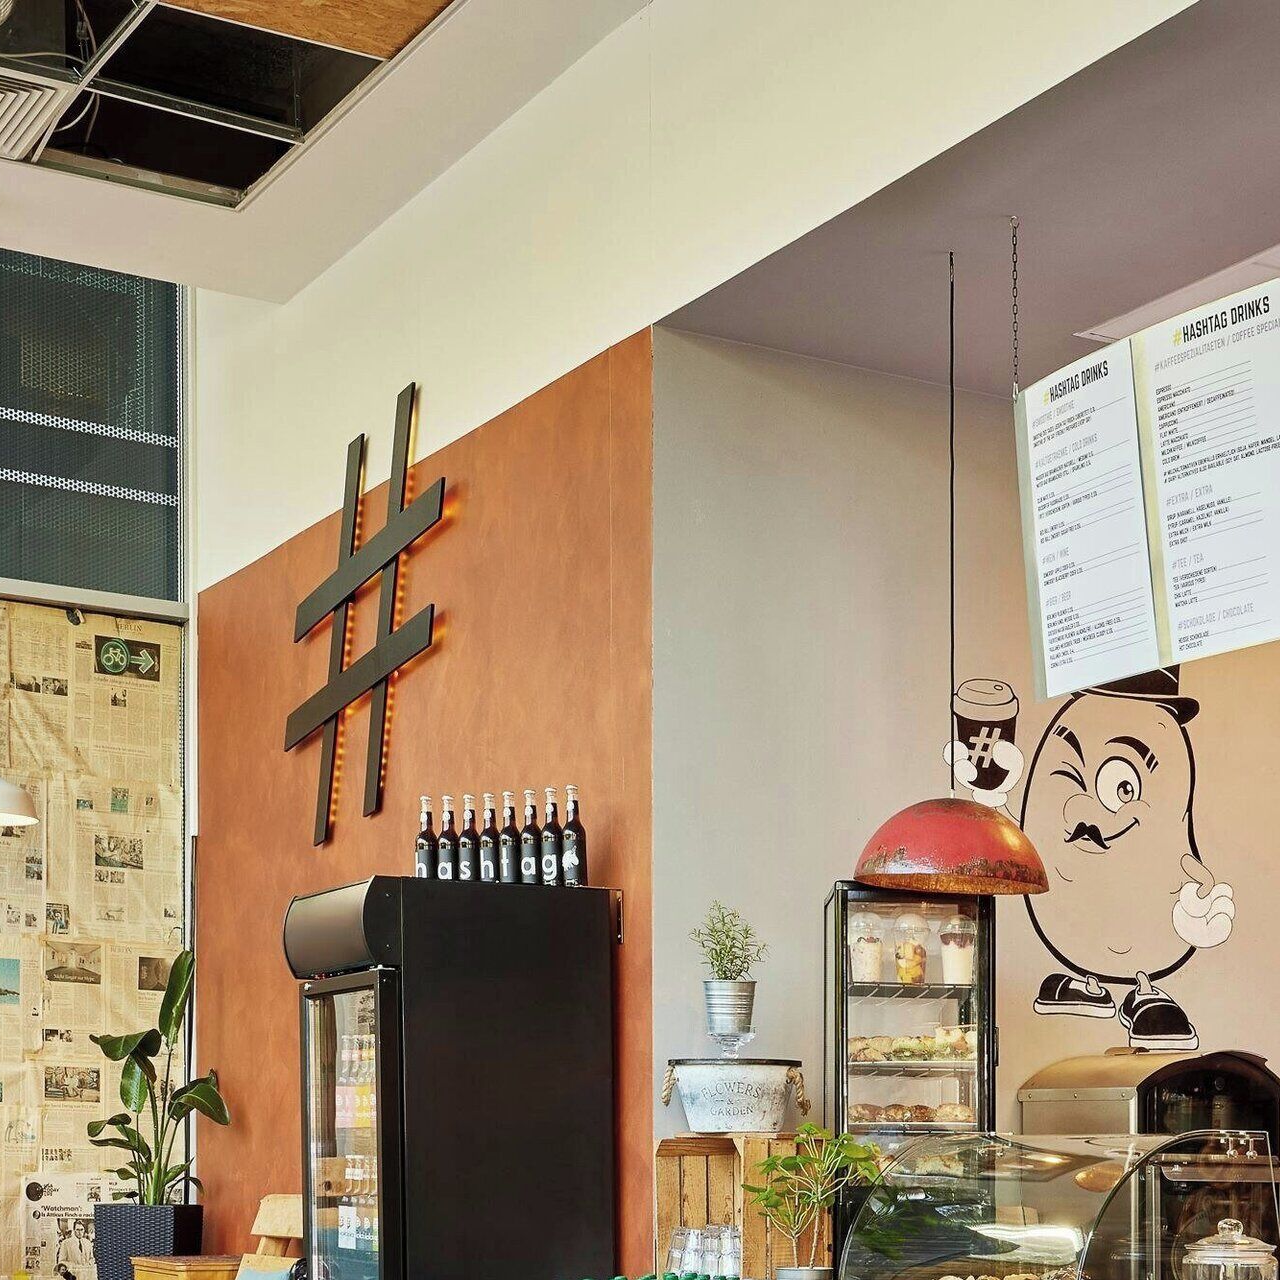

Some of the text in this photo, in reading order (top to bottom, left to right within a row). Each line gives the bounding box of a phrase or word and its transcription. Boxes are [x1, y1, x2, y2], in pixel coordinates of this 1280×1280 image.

[1172, 293, 1270, 348] #HASHTAG DRINKS
[1231, 325, 1254, 344] COFFEE
[1042, 357, 1108, 407] #HASHTAG DRINKS
[1194, 483, 1212, 498] EXTRA
[1193, 552, 1204, 564] TEA
[1222, 602, 1253, 619] CHOCOLATE
[700, 1081, 762, 1100] FLOWERS
[710, 1106, 754, 1117] GARDEN
